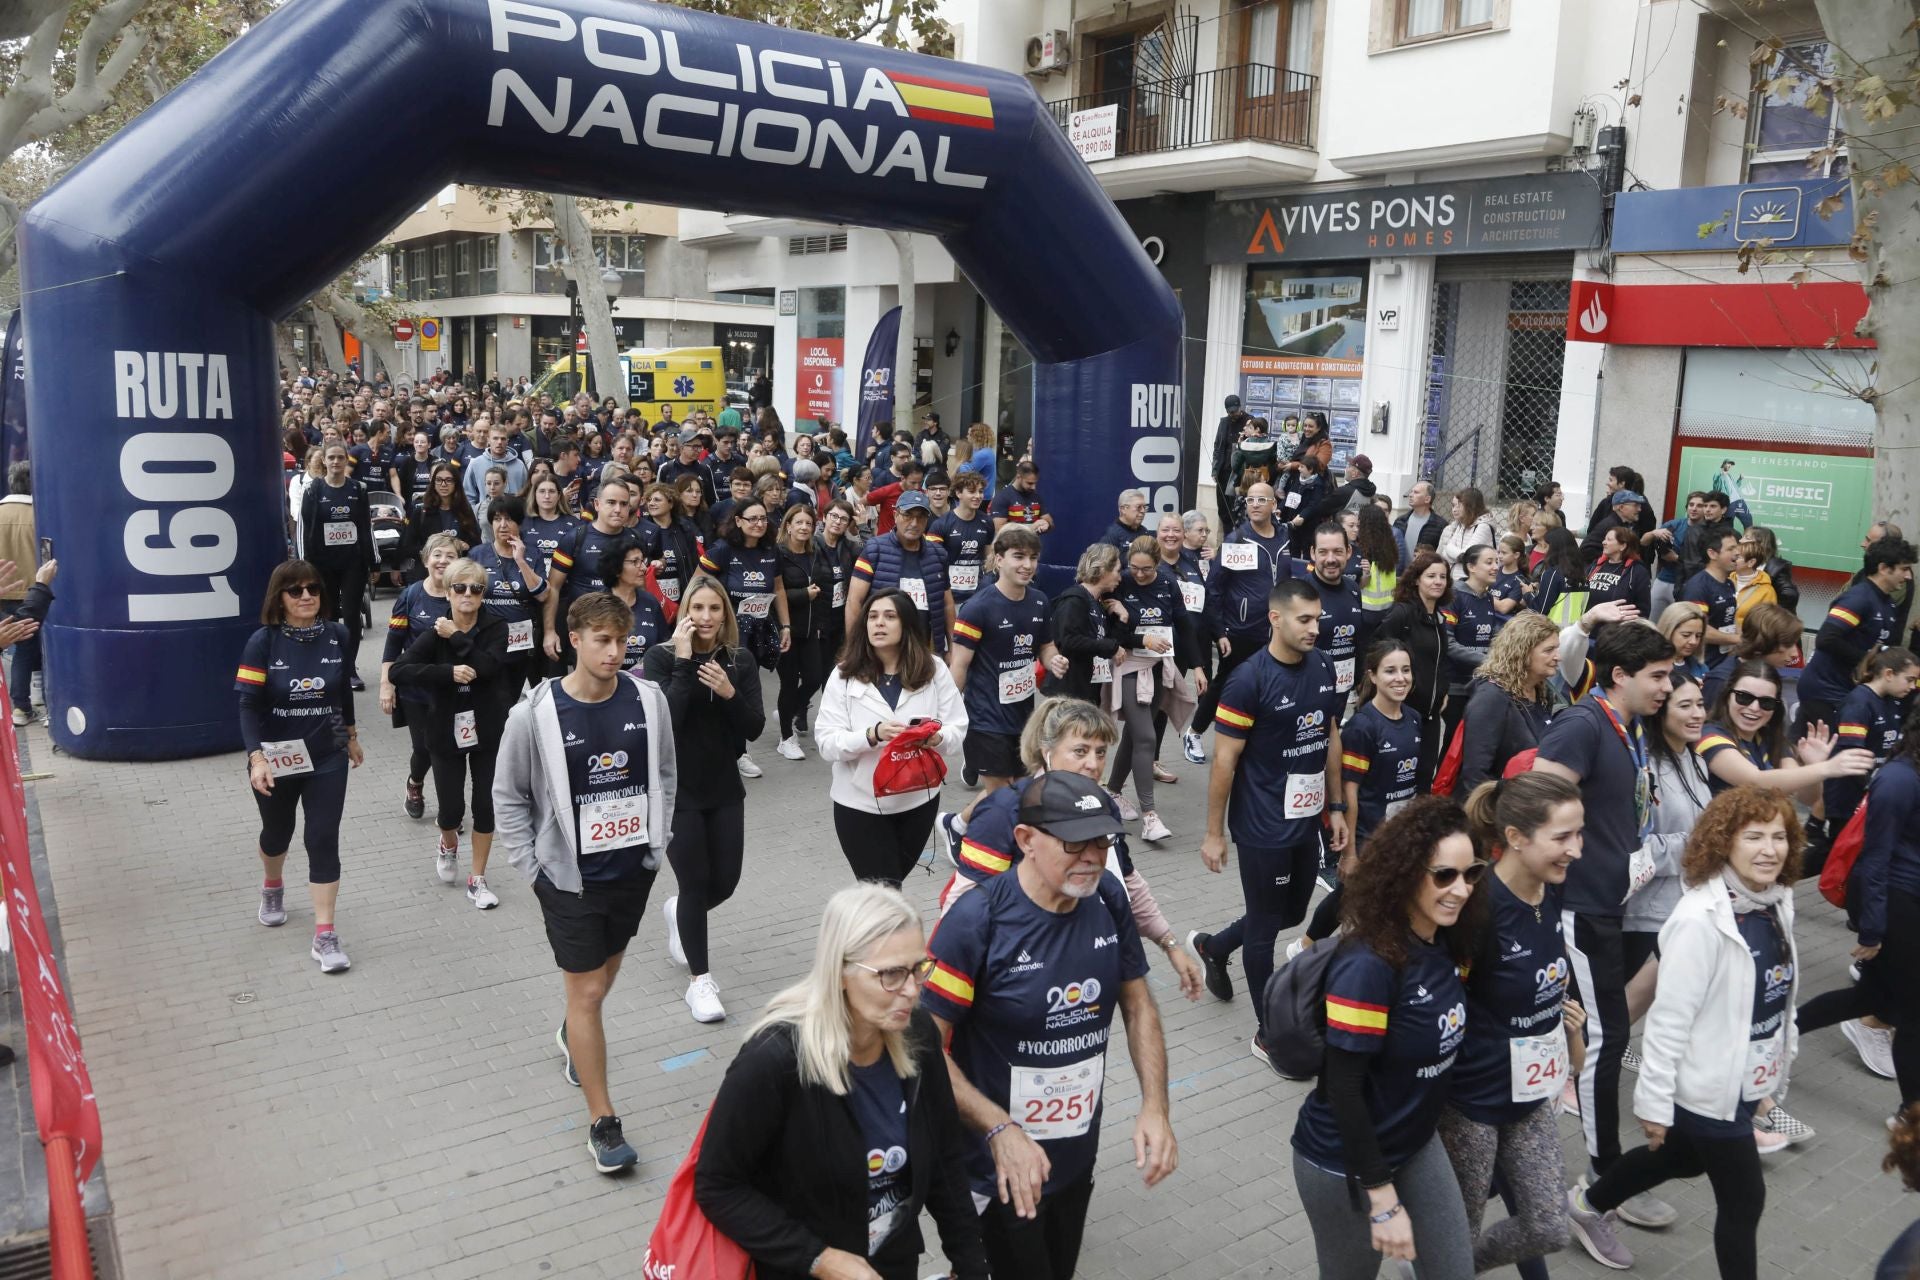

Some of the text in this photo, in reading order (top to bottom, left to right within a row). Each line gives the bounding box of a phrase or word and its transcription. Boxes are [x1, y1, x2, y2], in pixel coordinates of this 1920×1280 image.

[487, 68, 988, 189] NACIONAL
[1072, 126, 1112, 141] SE ALQUILA
[1074, 141, 1112, 155] 70 890 086
[1485, 191, 1553, 206] REAL ESTATE
[1281, 194, 1455, 236] VIVES PONS
[1482, 208, 1566, 224] CONSTRUCTION
[1368, 230, 1454, 248] HOMES
[1481, 227, 1561, 242] ARCHITECTURE
[1379, 310, 1396, 321] VP
[810, 347, 829, 356] LOCAL
[803, 357, 837, 367] DISPONIBLE
[1242, 360, 1264, 369] ESTUDIO
[1265, 361, 1272, 369] DE
[1273, 361, 1314, 370] ARQUITECTURA
[114, 351, 233, 419] RUTA
[1131, 383, 1181, 428] RUTA
[1751, 457, 1828, 469] BIENESTANDO
[1131, 436, 1181, 532] 09
[1766, 484, 1824, 501] SMUSIC
[119, 432, 241, 622] 091
[329, 531, 353, 541] 2061
[1226, 554, 1254, 564] 2094
[743, 571, 765, 581] 200
[952, 576, 975, 584] 2242
[1592, 572, 1621, 586] ETTER
[1183, 594, 1197, 605] 61
[1140, 608, 1161, 618] 200
[1333, 625, 1355, 638] 200
[627, 636, 646, 646] 00
[1014, 634, 1033, 646] 200
[290, 677, 325, 693] 200
[1006, 676, 1033, 696] 2555
[1337, 672, 1353, 685] 446
[1275, 702, 1296, 711] Santander
[1297, 710, 1324, 731] 200
[267, 753, 304, 770] 105
[588, 750, 628, 773] 200
[1397, 757, 1418, 774] 200
[588, 775, 629, 785] NACIONAL
[575, 785, 645, 805] #YOCORROCONLUC
[1293, 790, 1324, 809] 229
[591, 816, 640, 841] 2358
[1536, 957, 1568, 992] 200
[1047, 978, 1101, 1013] 200
[1046, 1013, 1100, 1030] NACIONAL
[1438, 1002, 1467, 1039] 200
[1753, 1060, 1780, 1086] 24
[1025, 1089, 1094, 1123] 2251
[868, 1146, 907, 1177] 00
